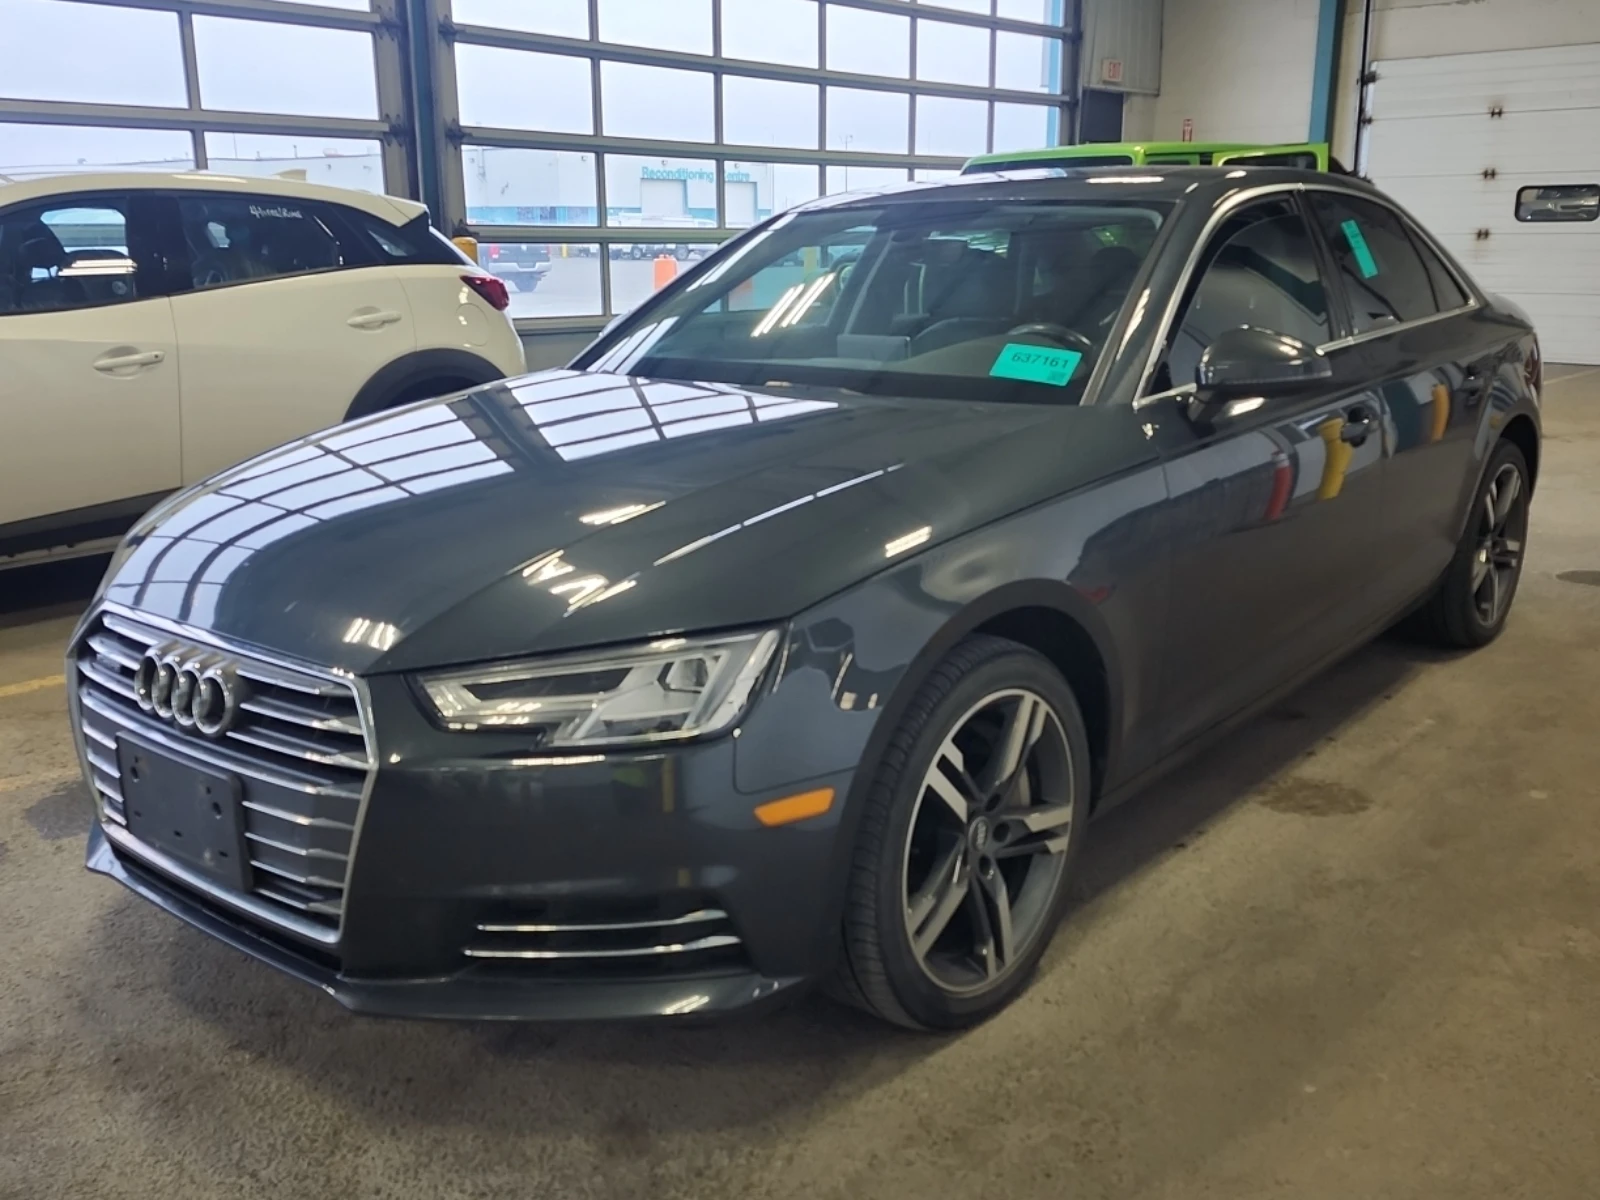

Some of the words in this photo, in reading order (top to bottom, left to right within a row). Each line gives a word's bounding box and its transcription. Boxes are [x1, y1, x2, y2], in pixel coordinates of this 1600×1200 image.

[641, 166, 715, 183] Reconditioning
[724, 170, 751, 182] entre
[1011, 351, 1069, 369] 637161
